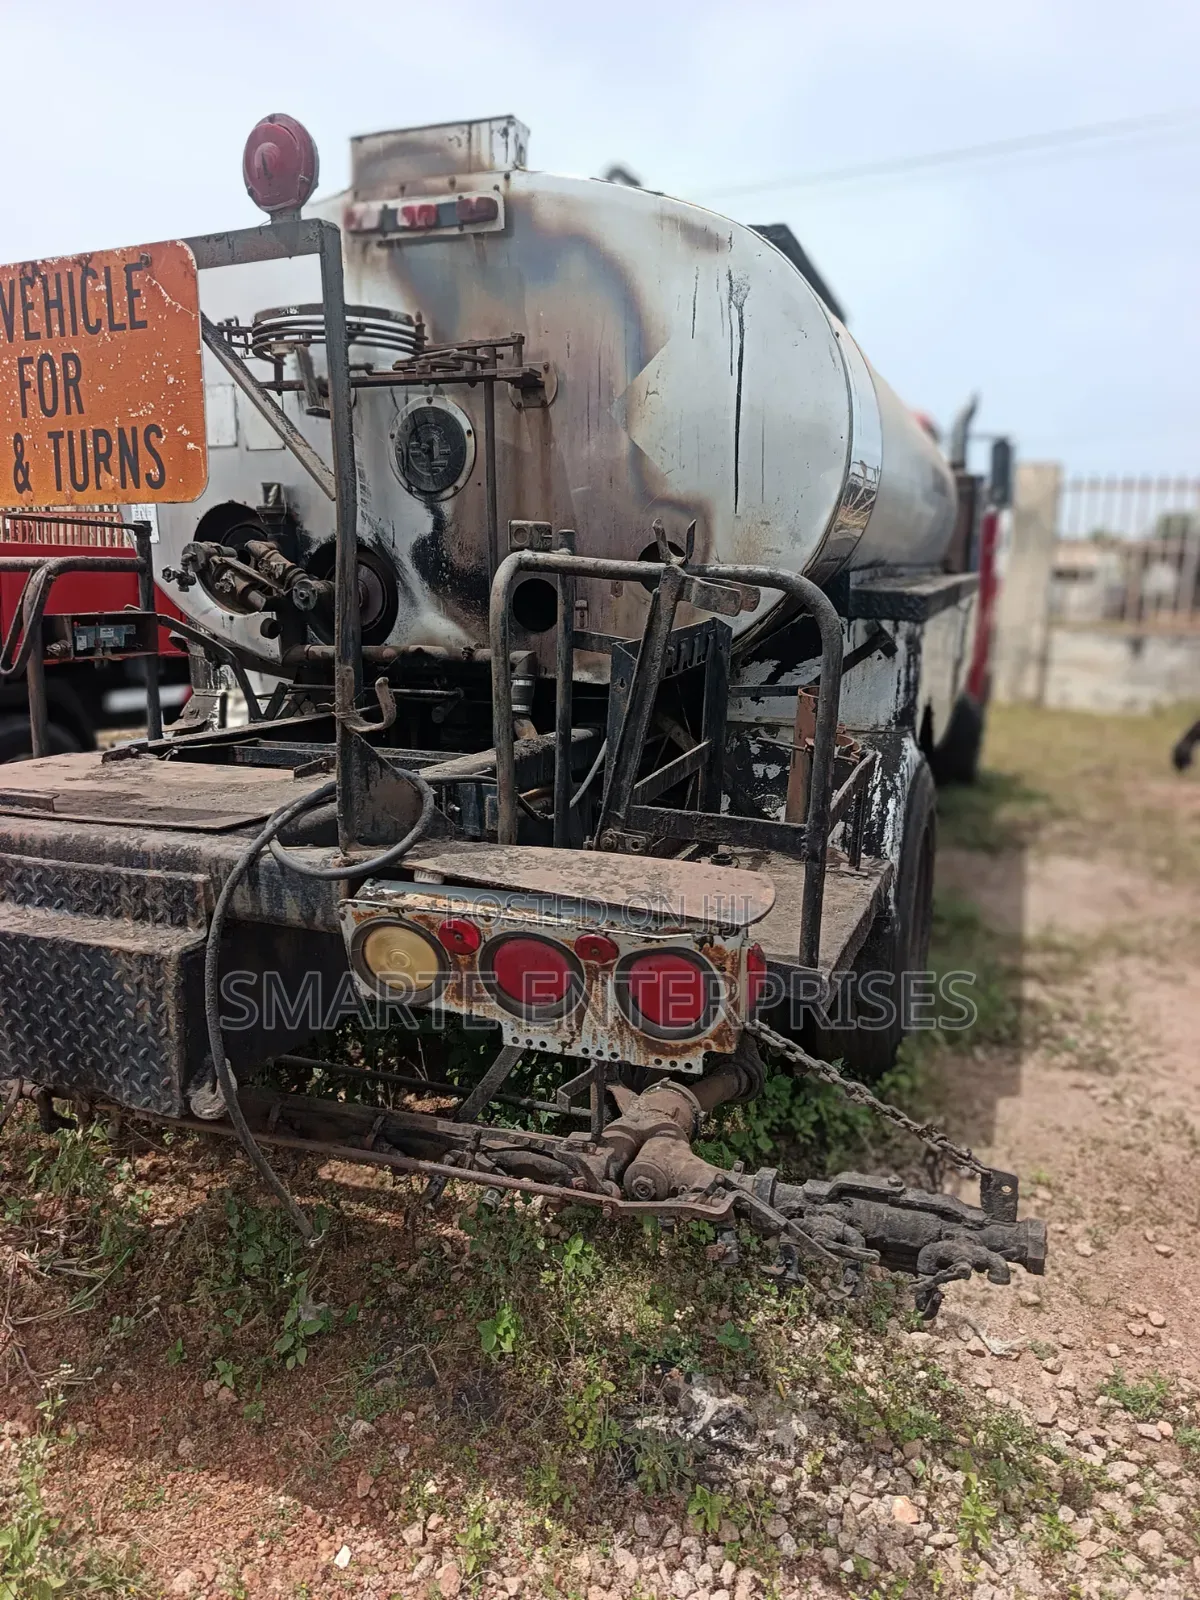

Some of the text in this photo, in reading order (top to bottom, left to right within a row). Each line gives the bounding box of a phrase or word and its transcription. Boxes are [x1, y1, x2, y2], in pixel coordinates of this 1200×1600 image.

[0, 262, 148, 343] VEHICLE
[18, 352, 85, 419] FOR
[13, 424, 166, 494] & TURNS
